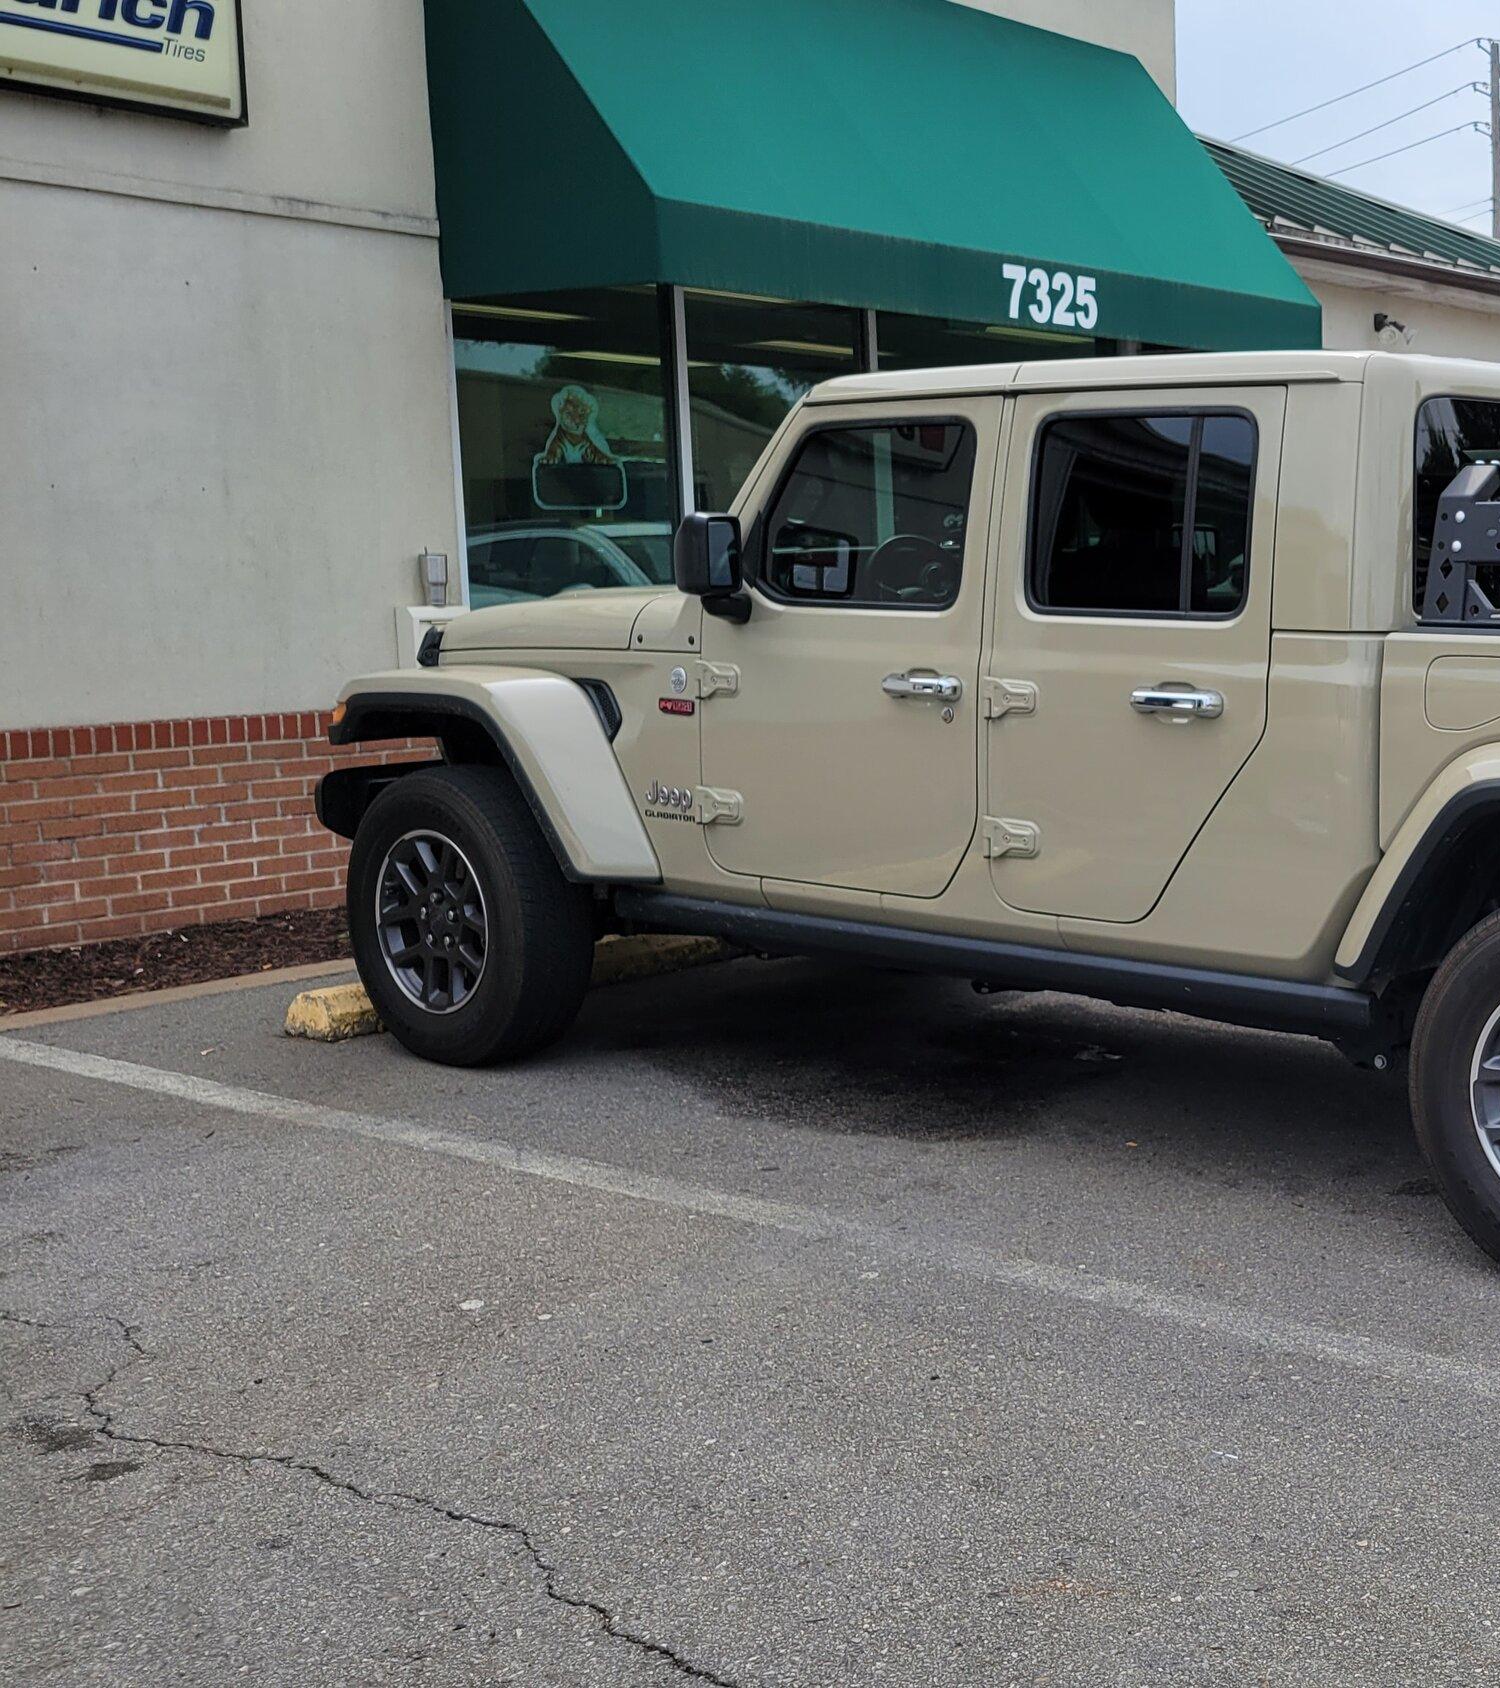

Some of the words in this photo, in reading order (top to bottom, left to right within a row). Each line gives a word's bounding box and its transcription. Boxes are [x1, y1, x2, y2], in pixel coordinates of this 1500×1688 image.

[163, 37, 205, 62] Tires
[1002, 263, 1098, 329] 7325
[645, 779, 692, 813] Jeep
[644, 809, 696, 823] GLADIATOR
